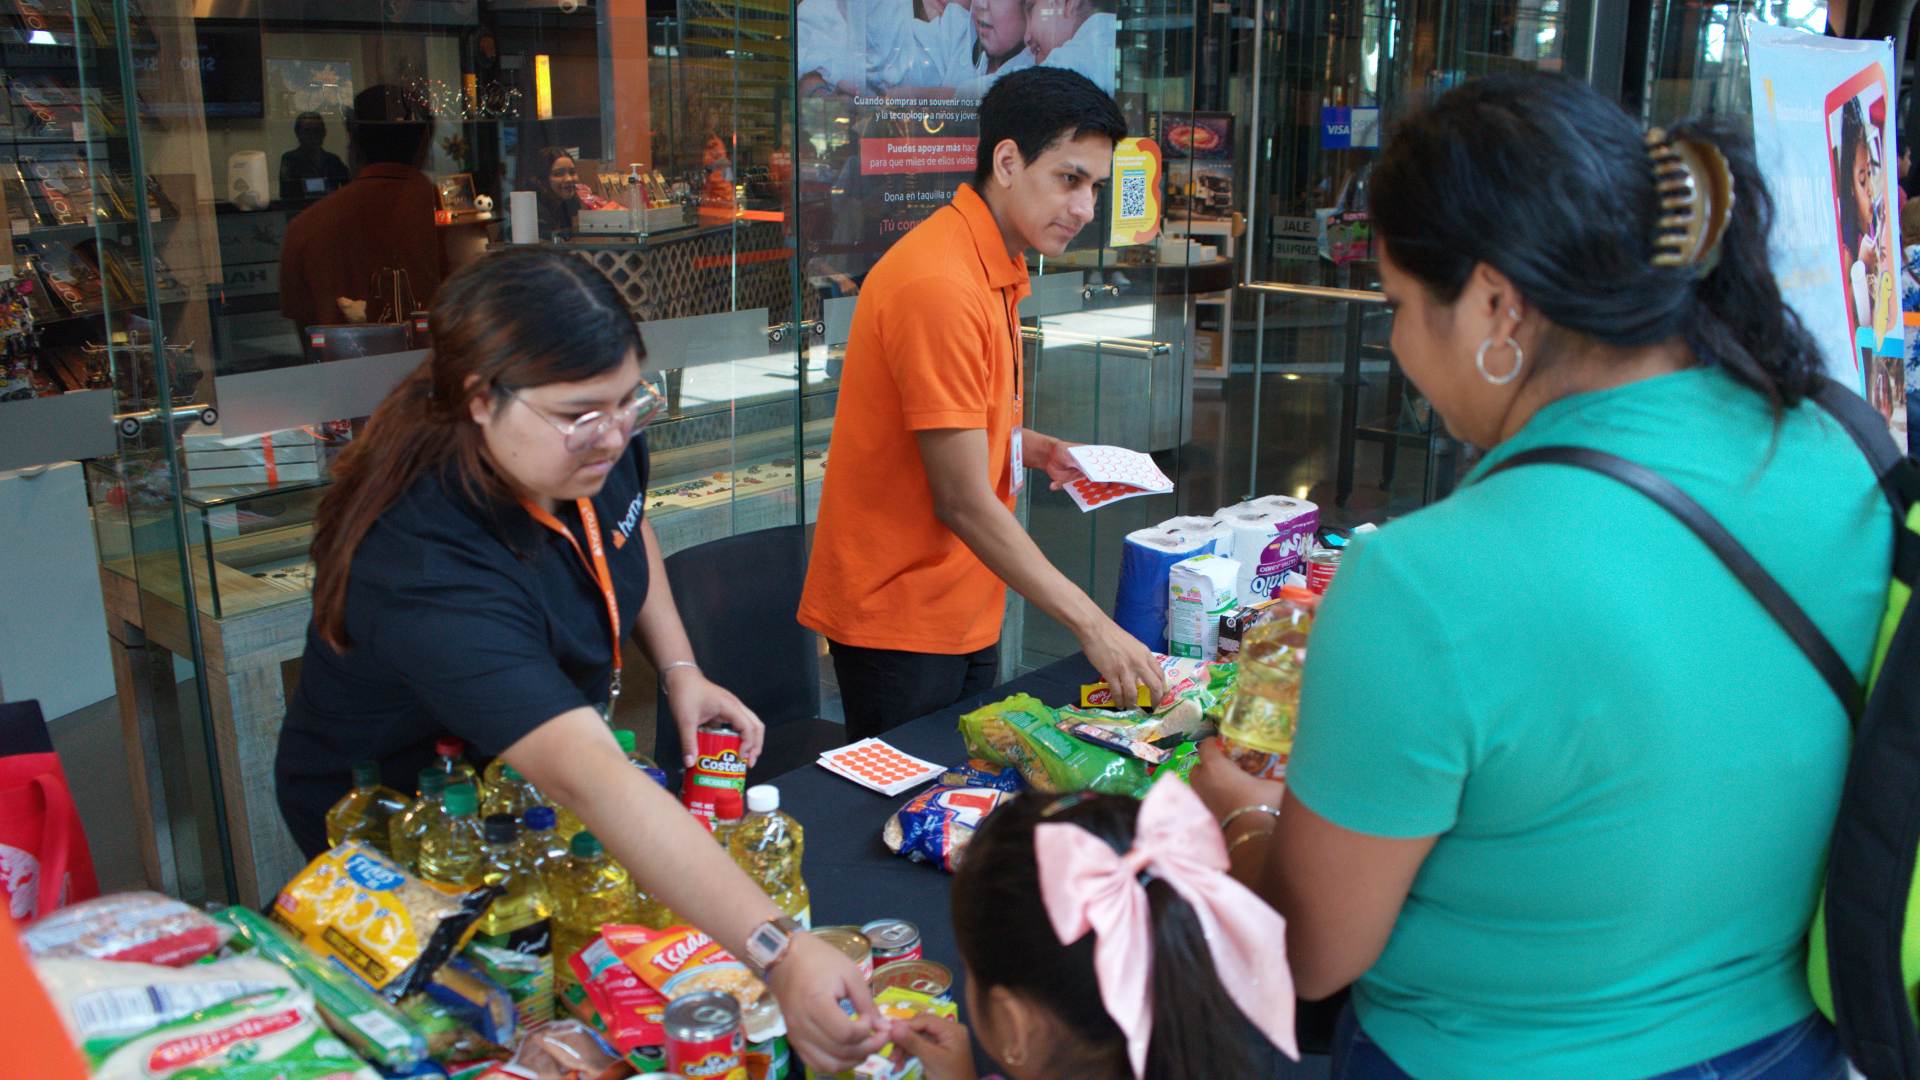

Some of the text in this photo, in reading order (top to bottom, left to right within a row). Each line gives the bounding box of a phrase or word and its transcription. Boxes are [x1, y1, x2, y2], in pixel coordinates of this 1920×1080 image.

[853, 96, 884, 106] Cuando
[885, 97, 918, 108] compras
[919, 98, 928, 106] un
[929, 98, 960, 107] souvenir
[961, 99, 974, 107] nos
[875, 112, 880, 122] y
[881, 110, 889, 120] la
[929, 112, 935, 120] a
[935, 110, 955, 120] niños
[955, 112, 960, 121] y
[960, 110, 978, 121] jóve
[1327, 124, 1350, 135] VISA
[887, 142, 977, 154] Puedes apoyar más hac
[869, 155, 978, 169] para que miles de ellos visite
[884, 192, 904, 202] Dona
[906, 192, 916, 201] en
[916, 190, 945, 202] taquilla
[946, 191, 952, 199] o
[897, 219, 921, 231] con
[1282, 221, 1312, 234] JALE
[722, 752, 736, 762] La
